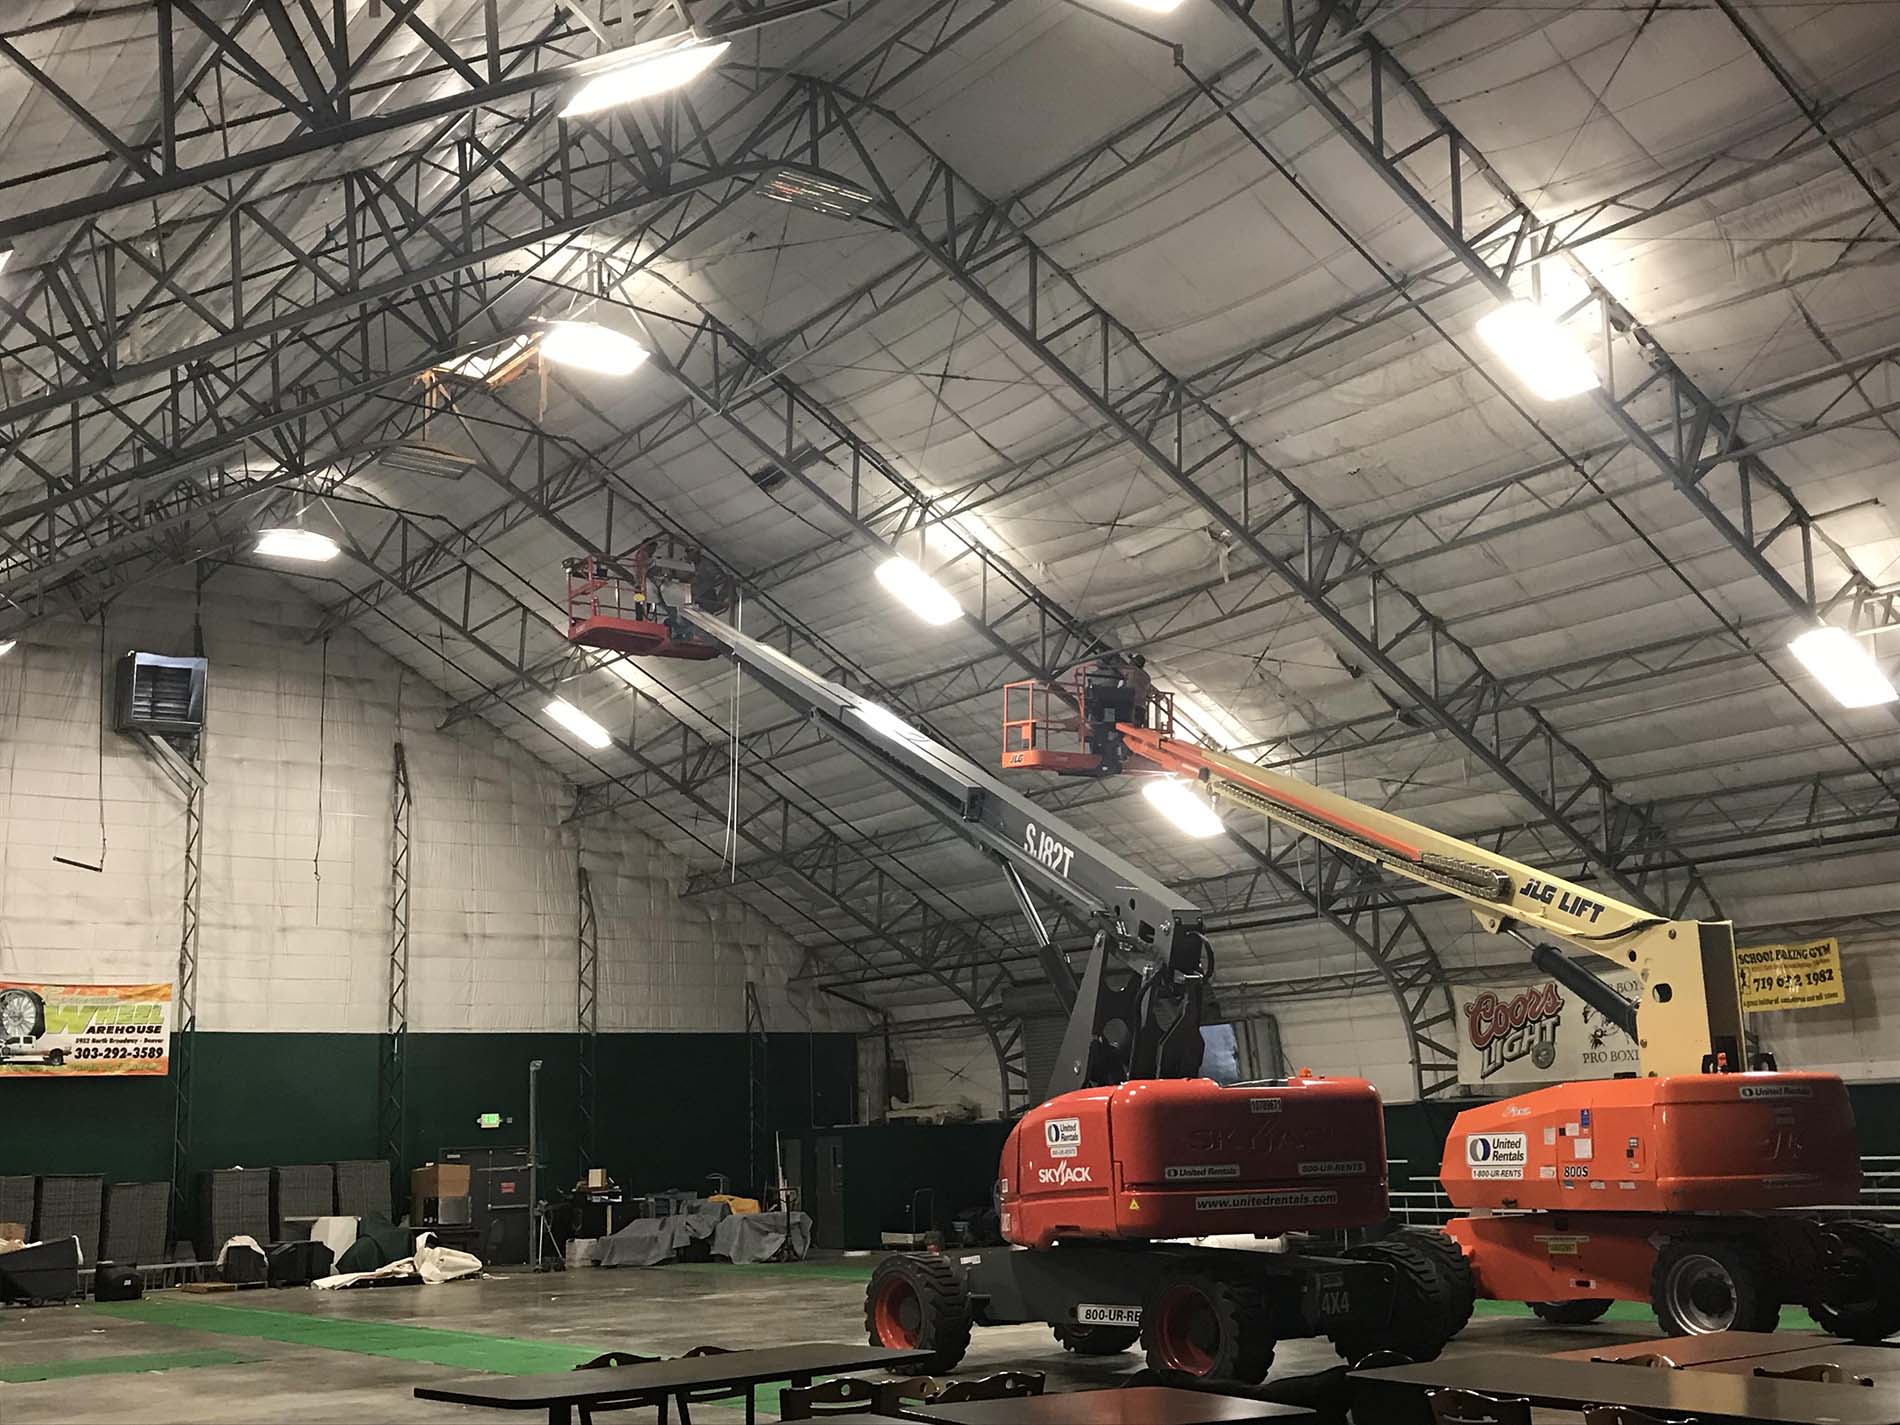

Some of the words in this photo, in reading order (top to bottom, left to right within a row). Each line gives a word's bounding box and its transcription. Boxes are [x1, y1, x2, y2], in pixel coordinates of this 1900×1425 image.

[1520, 878, 1558, 905] JLG
[1558, 891, 1606, 923] LIFT
[1738, 950, 1774, 965] SCHOOL
[1809, 943, 1831, 959] GYM
[1753, 977, 1773, 992] 719
[1806, 969, 1834, 986] 1982
[1464, 982, 1565, 1049] Coors
[74, 1047, 163, 1059] 303-292-3589
[1480, 1014, 1561, 1079] LIGHT
[1582, 1050, 1608, 1064] PRO
[1611, 1049, 1640, 1062] BOXI
[1492, 1138, 1521, 1149] United
[1492, 1150, 1524, 1162] Rentals
[1038, 1159, 1092, 1185] SKYJACK
[1179, 1167, 1206, 1177] United
[1208, 1166, 1237, 1176] Rentals
[1564, 1166, 1588, 1178] 800S
[1197, 1193, 1337, 1209] www.unitedrentals.com
[1085, 1309, 1141, 1322] 800-UR-RE
